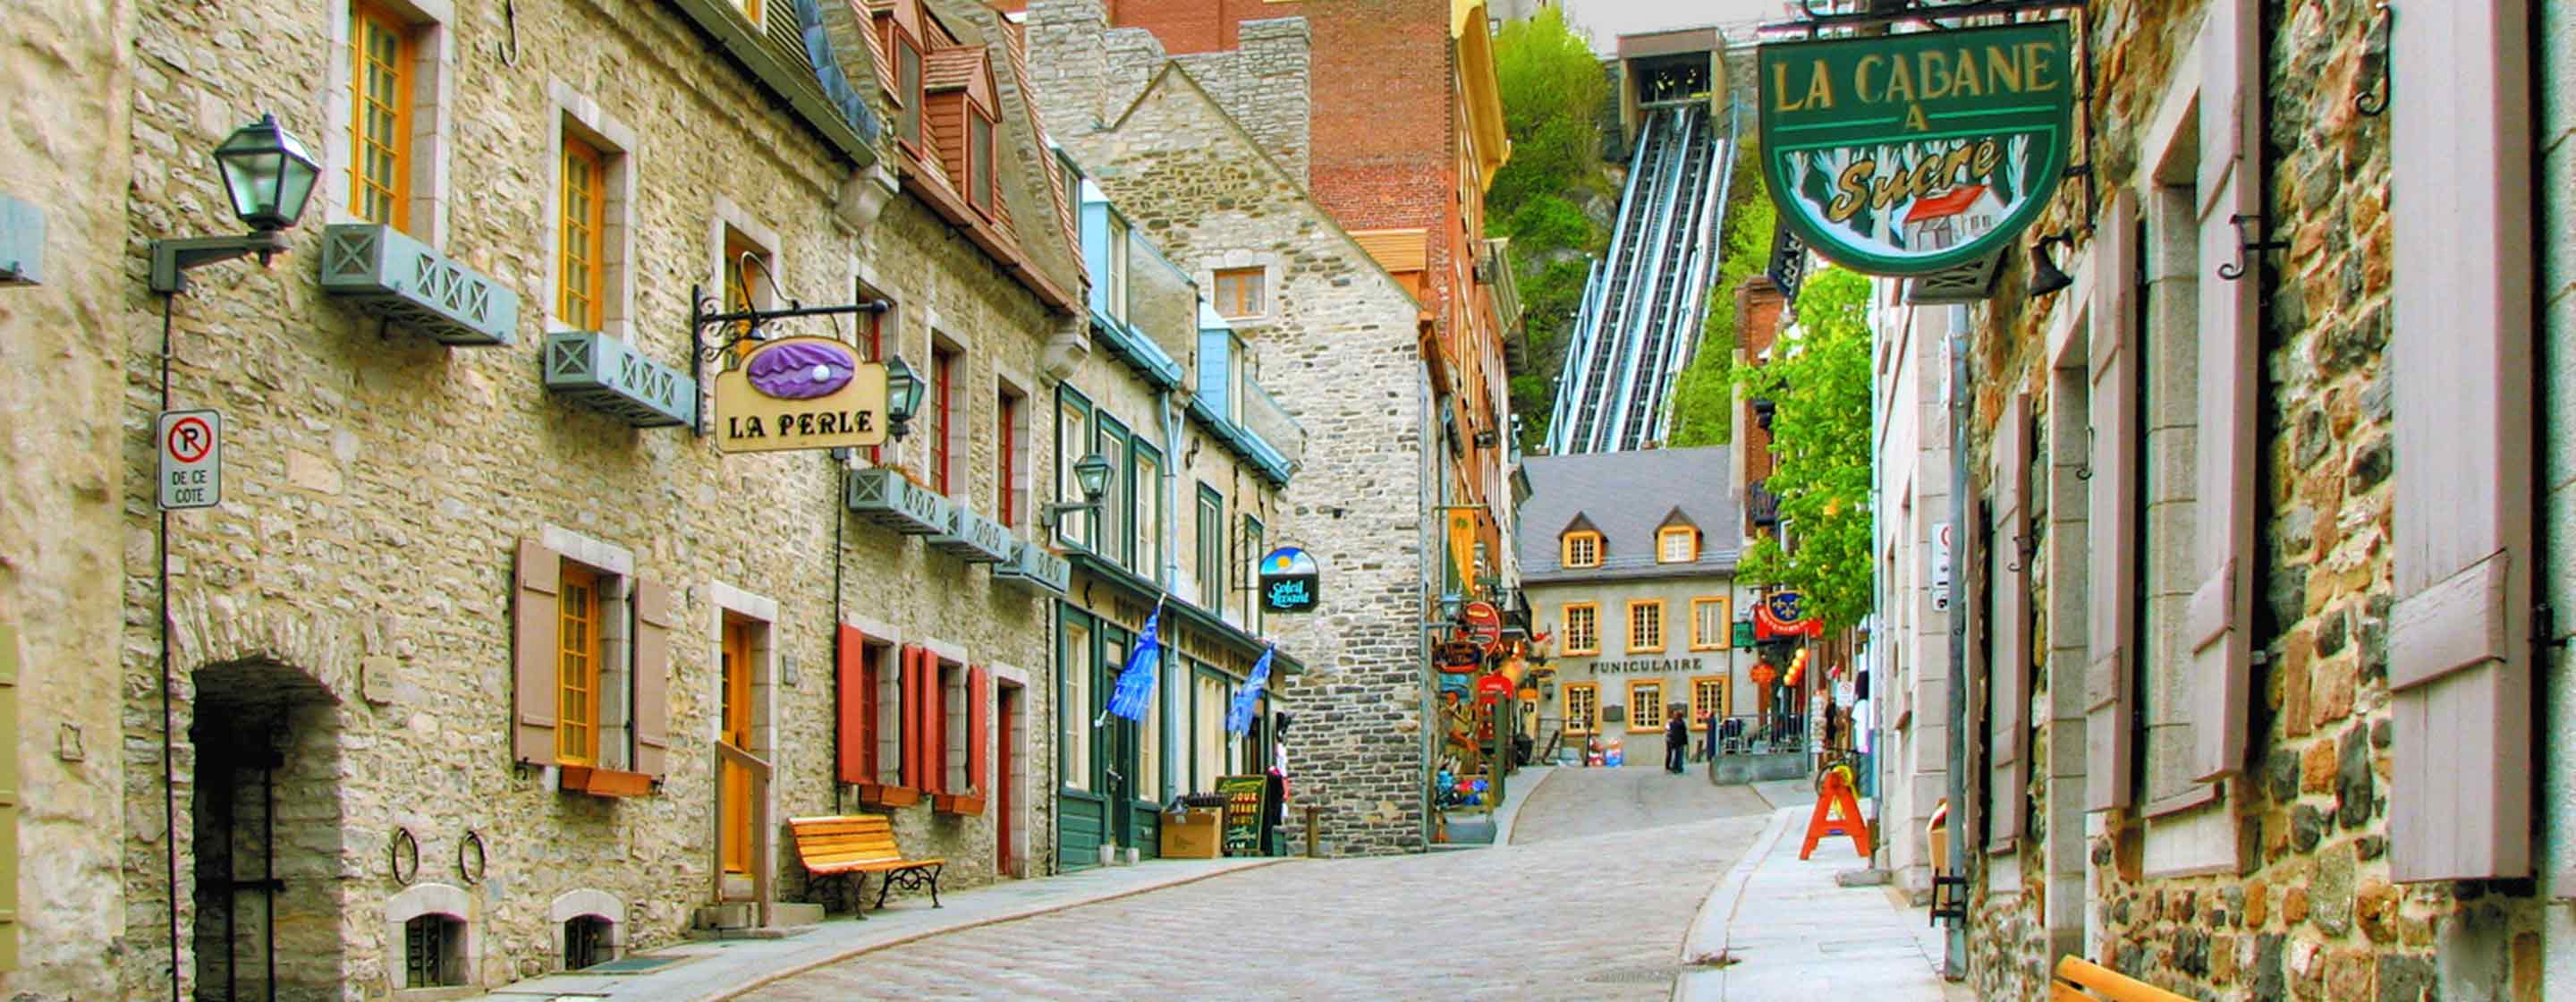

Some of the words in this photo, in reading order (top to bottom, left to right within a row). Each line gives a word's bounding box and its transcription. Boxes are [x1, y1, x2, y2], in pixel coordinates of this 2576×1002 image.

[1772, 60, 1834, 112] LA
[1854, 43, 2058, 103] CABANE
[729, 416, 766, 438] LA
[779, 410, 873, 437] PERLE
[173, 471, 187, 485] DE
[192, 470, 208, 484] CE
[1589, 658, 1702, 674] FUNICULAIRE
